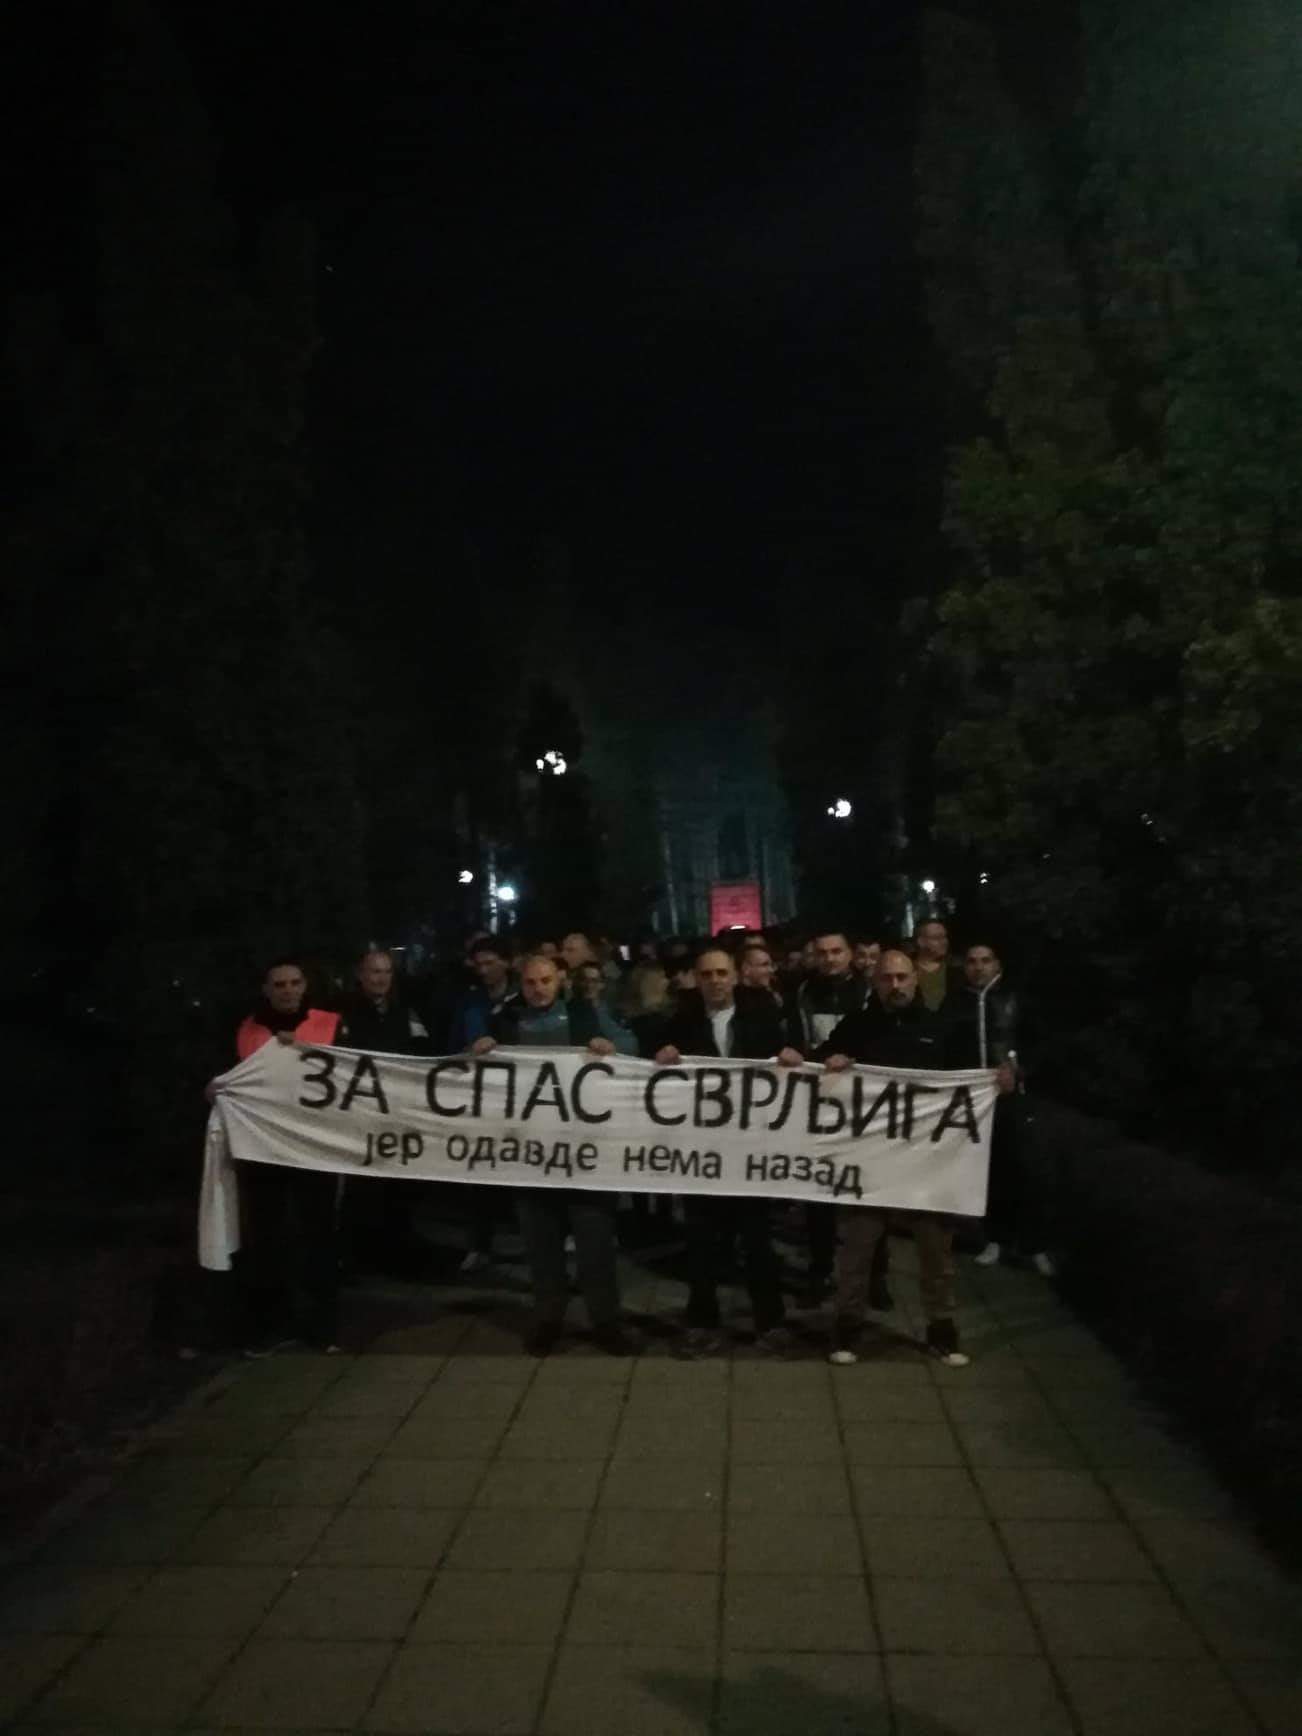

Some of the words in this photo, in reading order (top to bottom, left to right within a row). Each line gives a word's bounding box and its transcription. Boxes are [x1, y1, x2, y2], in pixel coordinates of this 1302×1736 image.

[299, 1052, 389, 1113] ЗА
[426, 1060, 613, 1123] СПАС
[644, 1067, 981, 1144] СВРЉИГА
[364, 1129, 423, 1167] јер
[447, 1134, 598, 1176] одавде
[623, 1145, 722, 1180] нема
[746, 1152, 863, 1198] назад
